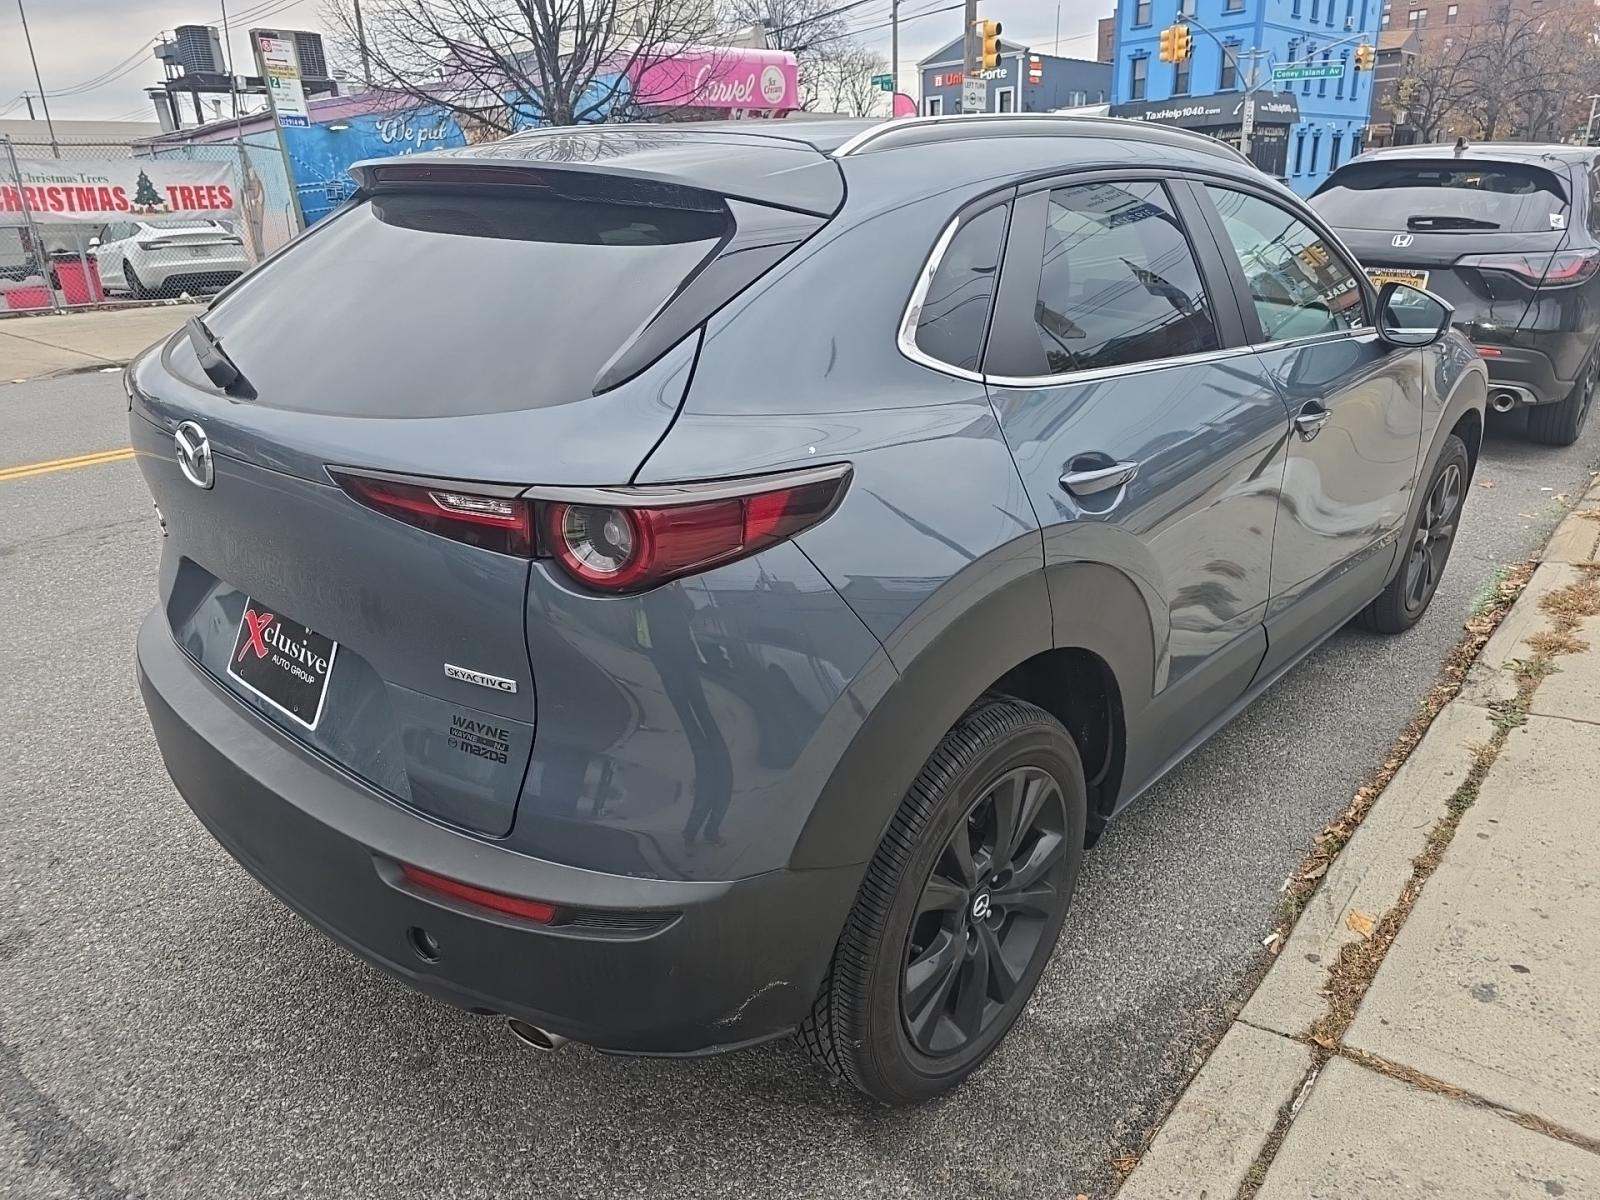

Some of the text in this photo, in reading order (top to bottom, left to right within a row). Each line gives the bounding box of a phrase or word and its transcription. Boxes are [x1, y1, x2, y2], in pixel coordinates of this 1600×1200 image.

[694, 64, 756, 103] Carvel
[1302, 68, 1326, 76] Island
[1329, 67, 1340, 75] Av
[375, 117, 448, 149] We put
[78, 172, 110, 184] Trees
[0, 185, 234, 213] HRISTMAS TREES
[237, 609, 328, 675] Xclusive
[271, 653, 315, 685] AUTO GROUP
[452, 714, 510, 742] WAYNE
